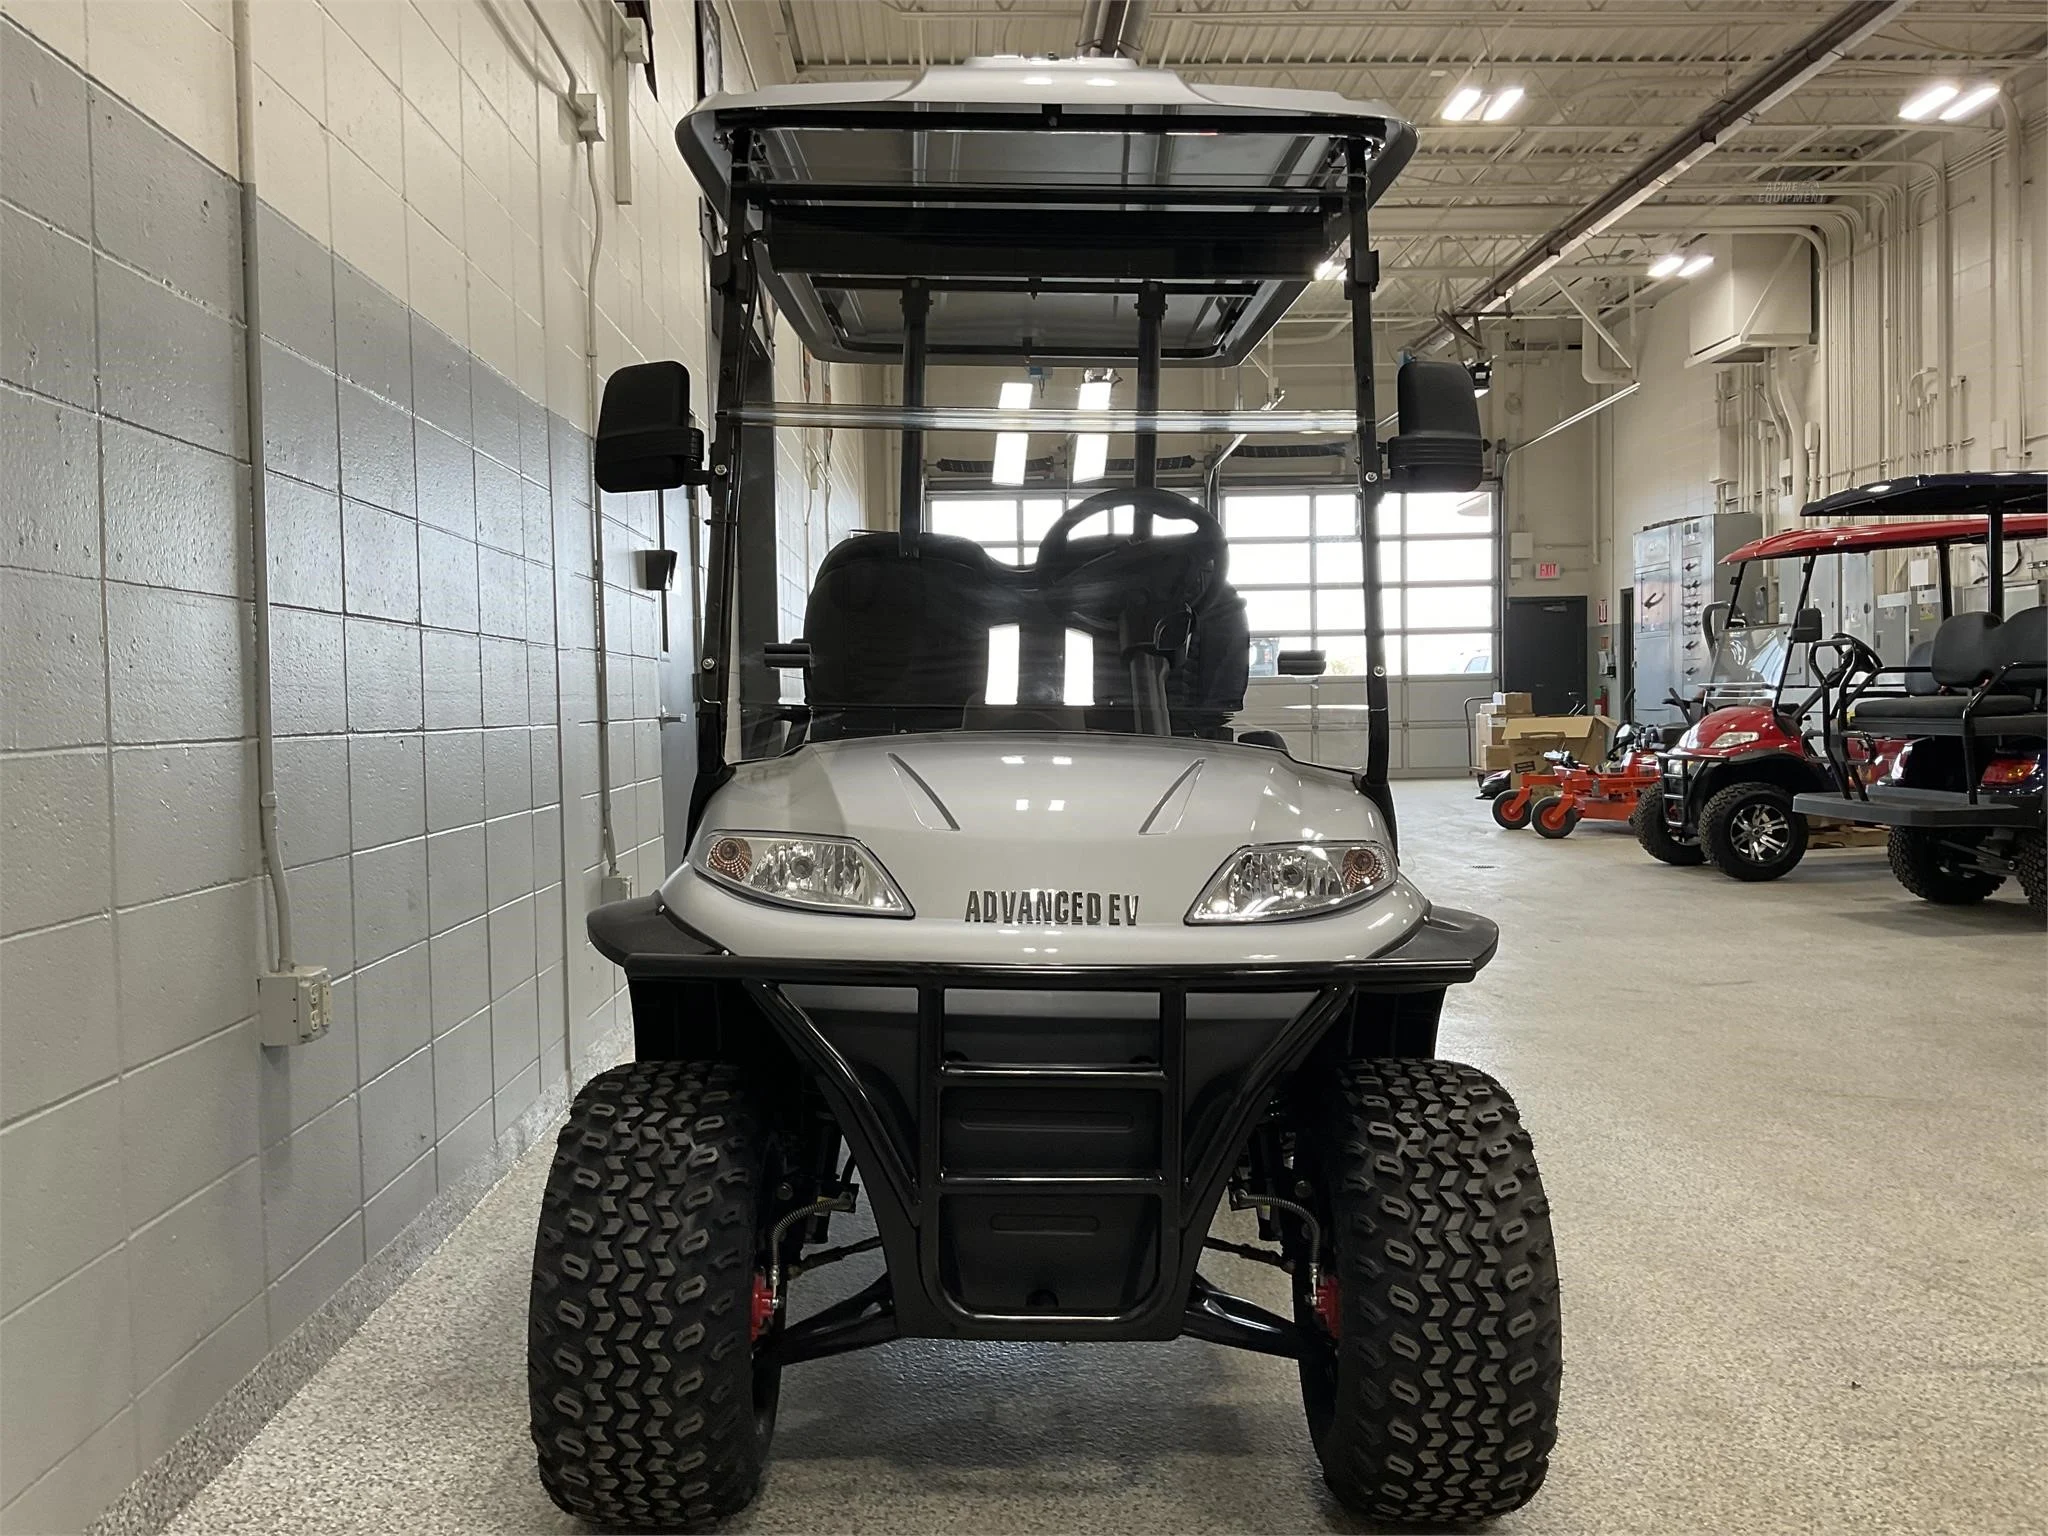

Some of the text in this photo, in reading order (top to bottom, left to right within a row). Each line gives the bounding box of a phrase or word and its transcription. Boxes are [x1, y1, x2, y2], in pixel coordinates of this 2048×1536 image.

[1540, 563, 1557, 577] EXIT
[965, 890, 1140, 926] ADVANCED EV
